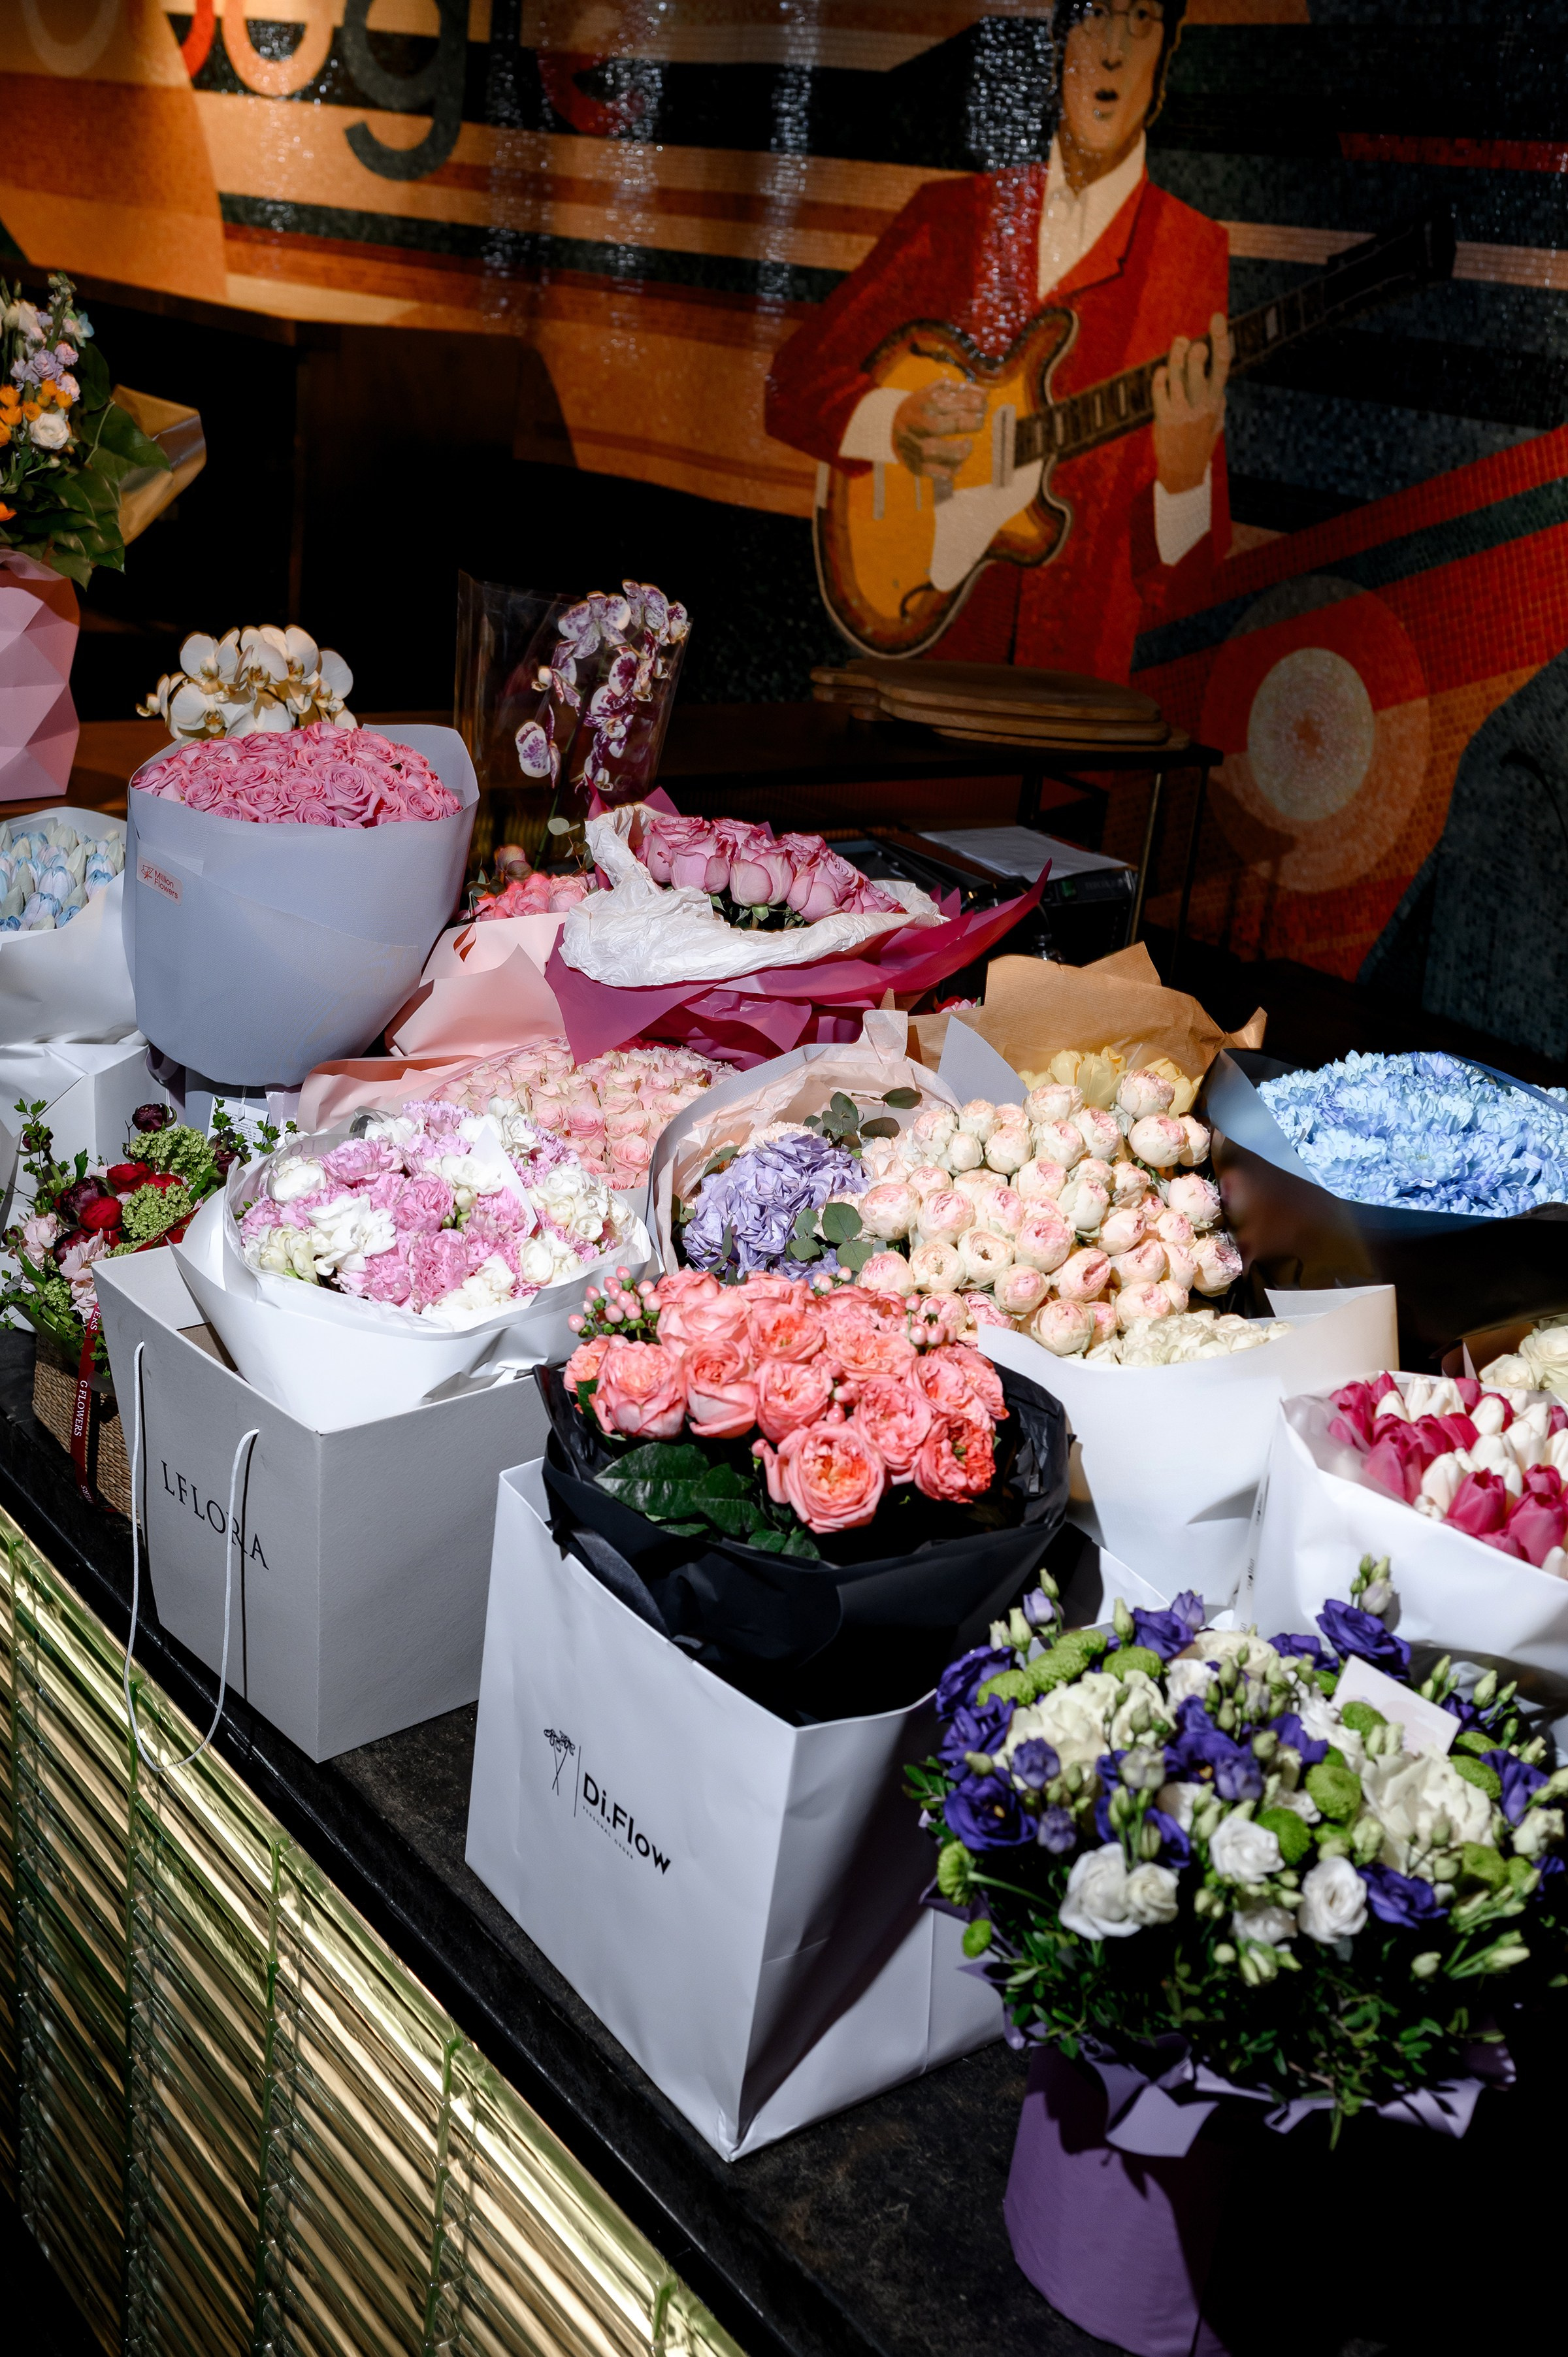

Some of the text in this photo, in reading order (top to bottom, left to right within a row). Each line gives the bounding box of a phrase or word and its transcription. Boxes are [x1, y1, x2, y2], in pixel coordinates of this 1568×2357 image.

[154, 870, 174, 889] Million
[154, 878, 178, 899] Flowers
[74, 1389, 87, 1436] FLOWERS
[583, 1772, 671, 1875] Di.Flow
